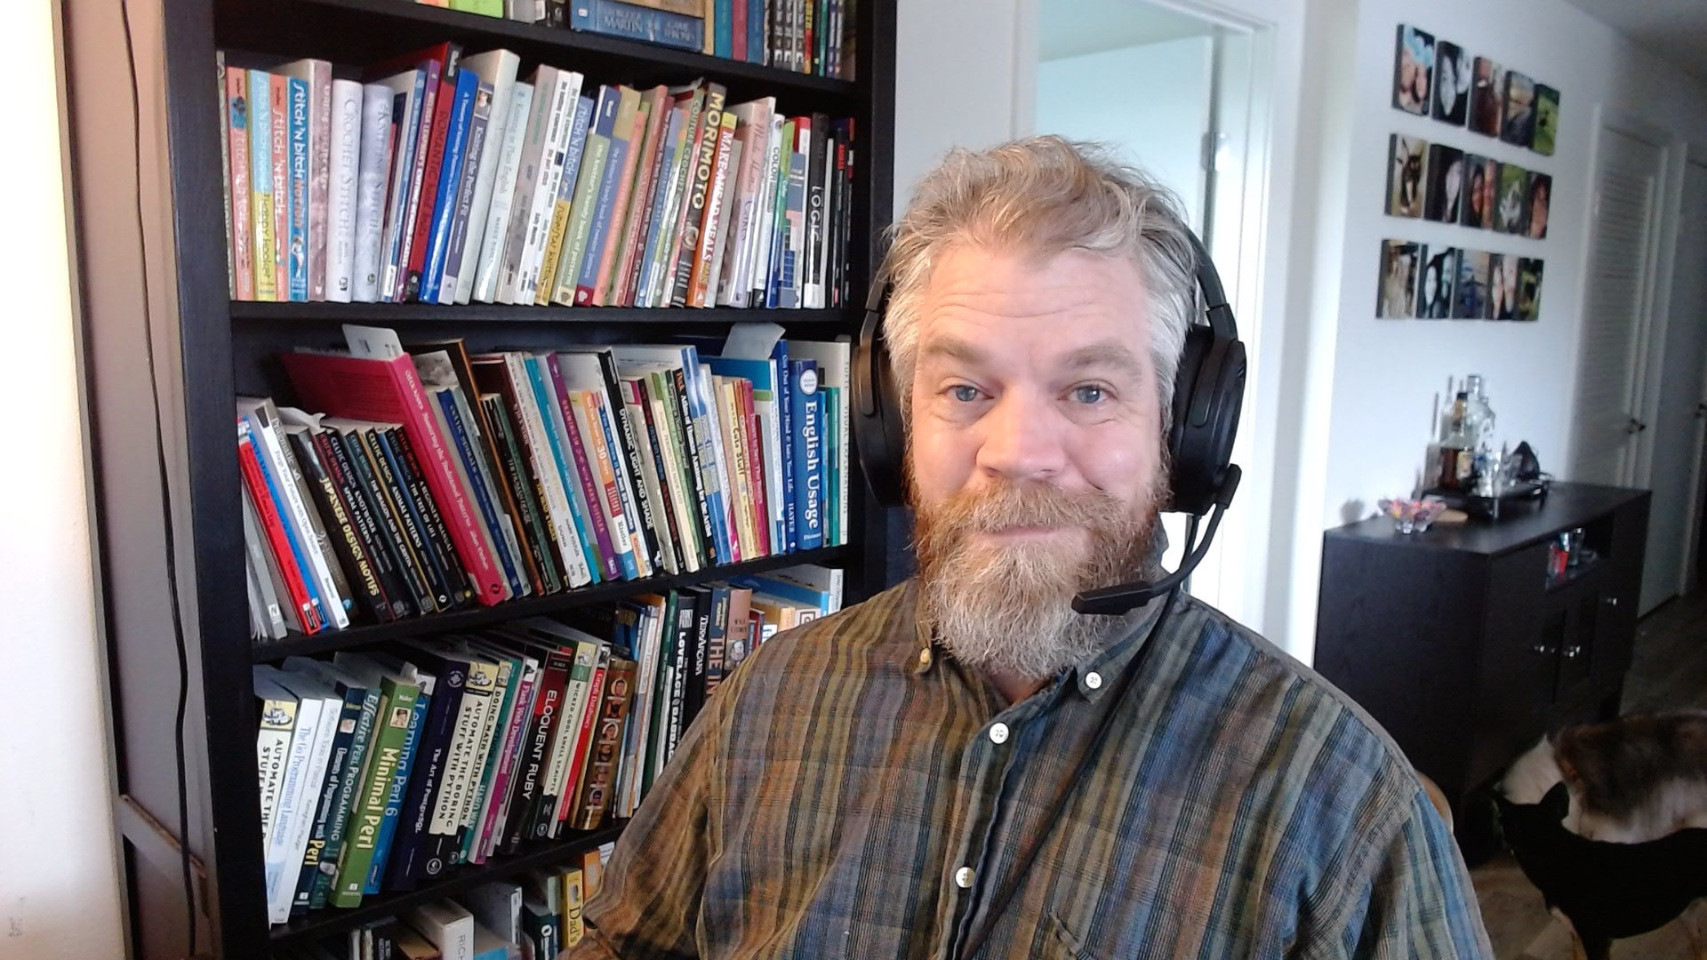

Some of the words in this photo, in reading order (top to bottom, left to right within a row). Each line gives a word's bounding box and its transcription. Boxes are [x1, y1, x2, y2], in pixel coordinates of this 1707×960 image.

[428, 109, 449, 179] ROMANTIC
[469, 125, 483, 163] Knitting
[594, 144, 603, 157] the
[691, 91, 725, 210] MORIMOTO
[466, 162, 477, 175] the
[586, 158, 600, 193] knitter's
[462, 175, 474, 204] Perfect
[460, 204, 469, 216] Fit
[580, 194, 592, 218] handy
[597, 203, 606, 219] book
[809, 185, 821, 241] LOGIC
[575, 220, 586, 240] book
[573, 241, 581, 251] of
[565, 251, 578, 285] patterns
[679, 394, 689, 413] Atlas
[600, 413, 608, 426] You
[603, 427, 611, 440] Can
[683, 415, 691, 425] of
[269, 416, 296, 465] Pragmatic
[685, 424, 696, 454] Human
[732, 427, 741, 448] Cute
[801, 400, 818, 471] English
[420, 411, 441, 449] Mastering
[435, 447, 445, 460] the
[441, 460, 460, 497] Traditional
[596, 444, 607, 459] 30
[607, 441, 617, 461] Draw
[736, 452, 744, 475] Stuff
[616, 475, 625, 491] Just
[618, 407, 634, 450] DYNAMIC
[629, 451, 640, 476] LIGHT
[635, 478, 645, 498] AND
[641, 500, 653, 529] SHADE
[329, 436, 345, 462] CELTIC
[340, 461, 357, 489] DESIGN
[353, 490, 376, 533] KNOTWORK
[367, 432, 382, 457] CELTIC
[378, 456, 393, 483] DESIGN
[390, 485, 407, 513] ANIMAL
[403, 513, 422, 548] PATTERNS
[621, 492, 628, 501] 30
[375, 491, 390, 518] DRAGON
[387, 518, 397, 532] AND
[623, 502, 635, 529] Minutes
[700, 501, 708, 515] the
[803, 473, 820, 529] Usage
[294, 504, 305, 518] with
[300, 518, 311, 534] Open
[353, 510, 372, 544] PATTERNS
[421, 513, 430, 523] OF
[703, 515, 712, 537] Artist
[318, 474, 348, 525] JAPANESE
[340, 523, 365, 561] DESIGN
[356, 558, 381, 597] MOTIFS
[673, 631, 688, 698] LOVELACE
[708, 634, 725, 671] THE
[518, 683, 530, 706] Flask
[569, 682, 581, 712] WICKED
[592, 672, 603, 694] Graph
[355, 693, 379, 743] Effective
[488, 690, 501, 721] DOING
[513, 706, 524, 725] Web
[298, 725, 311, 740] The
[397, 701, 425, 771] Learning
[457, 705, 471, 739] STUFF
[462, 700, 483, 757] AUTOMATE
[480, 723, 492, 750] MATH
[531, 689, 556, 760] ELOQUENT
[564, 714, 573, 734] COOL
[666, 706, 679, 759] BABBAG
[295, 741, 307, 754] Go
[330, 746, 346, 775] Elements
[349, 743, 364, 766] PERL
[431, 747, 441, 762] The
[450, 741, 463, 770] WITH
[500, 725, 519, 774] Development
[557, 735, 567, 758] SHELL
[265, 738, 284, 802] AUTOMATE
[366, 745, 399, 812] Minimal
[427, 763, 437, 777] Art
[457, 760, 468, 781] THE
[472, 752, 484, 778] WITH
[549, 759, 561, 792] SCRIPTS
[282, 754, 305, 809] Programming
[388, 774, 406, 804] Perl
[425, 778, 434, 787] of
[521, 763, 539, 800] RUBY
[318, 782, 337, 824] Programming
[330, 765, 359, 842] PROGRAMMING
[384, 805, 397, 817] 6
[413, 787, 431, 834] PostgreSQL
[438, 774, 455, 820] PYTHON
[445, 784, 462, 828] BORING
[461, 780, 476, 820] PYTHON
[273, 808, 292, 847] Language
[314, 824, 327, 840] with
[356, 812, 381, 851] Perl
[304, 837, 325, 868] Perl
[570, 906, 581, 943] Dad's
